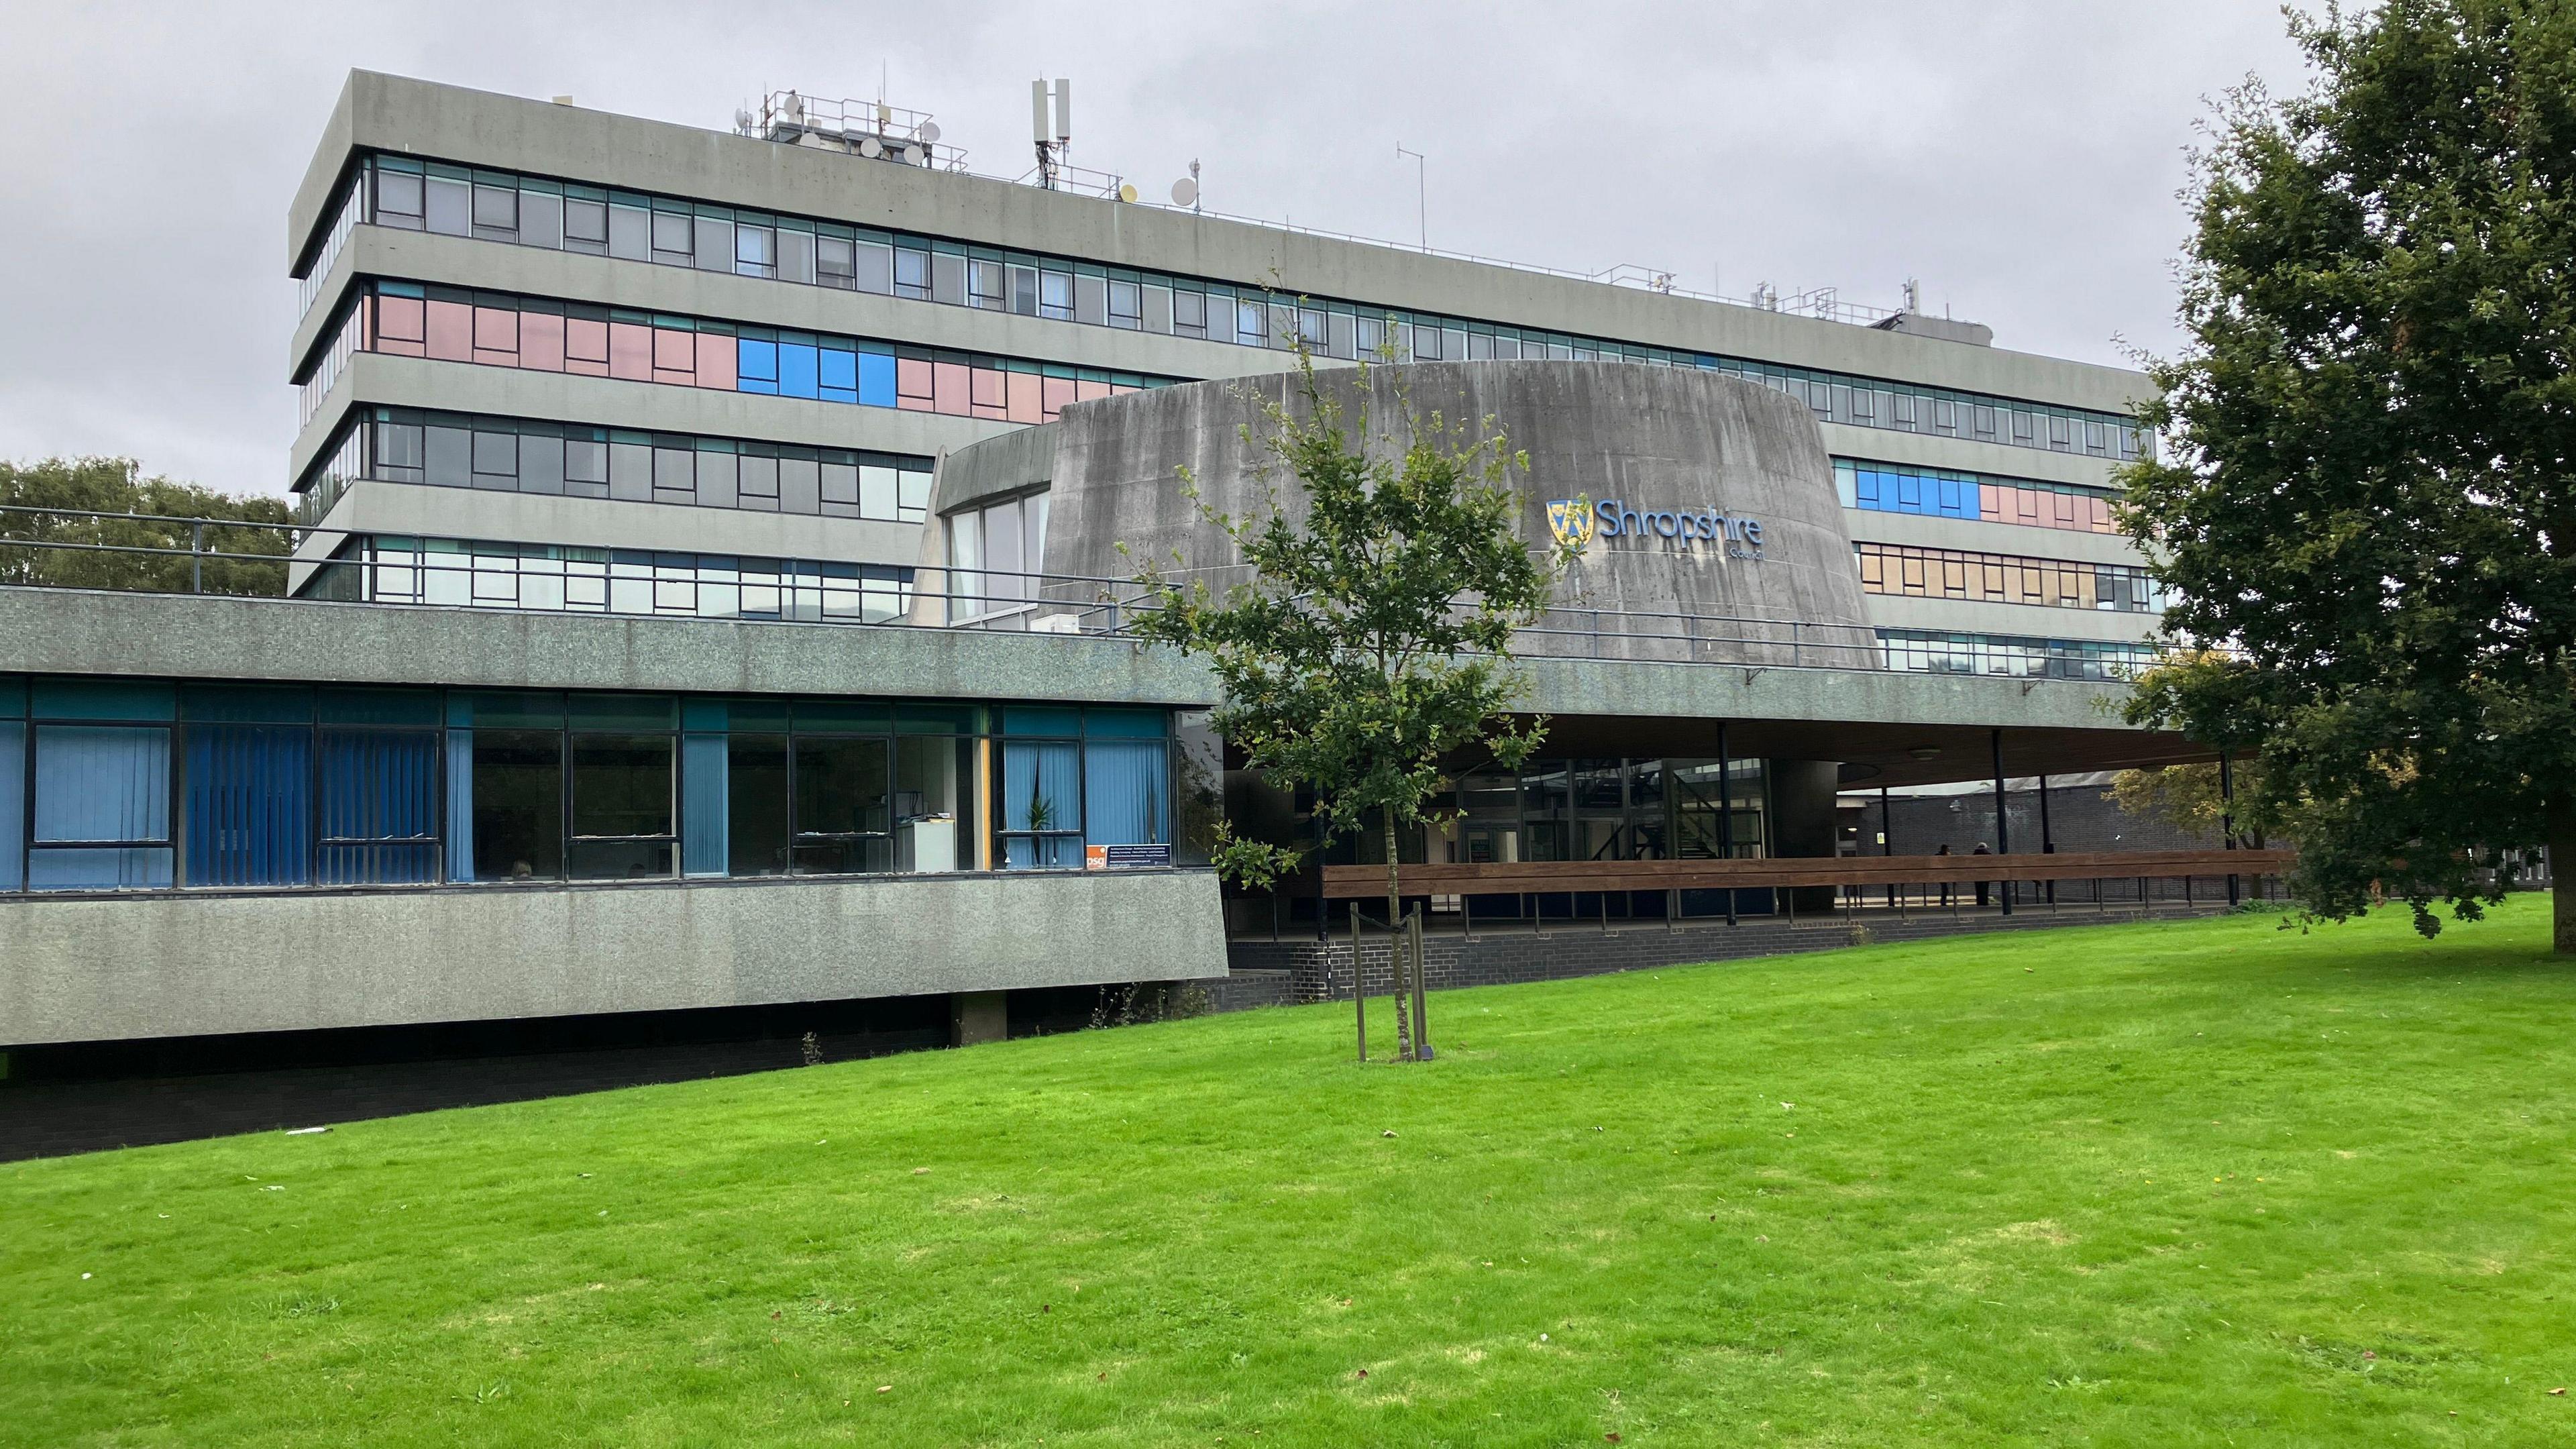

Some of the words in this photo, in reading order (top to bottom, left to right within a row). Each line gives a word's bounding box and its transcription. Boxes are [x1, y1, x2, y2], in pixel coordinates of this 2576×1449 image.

[1596, 500, 1762, 549] Shropshire
[1729, 547, 1764, 561] Council
[1087, 857, 1105, 867] psg
